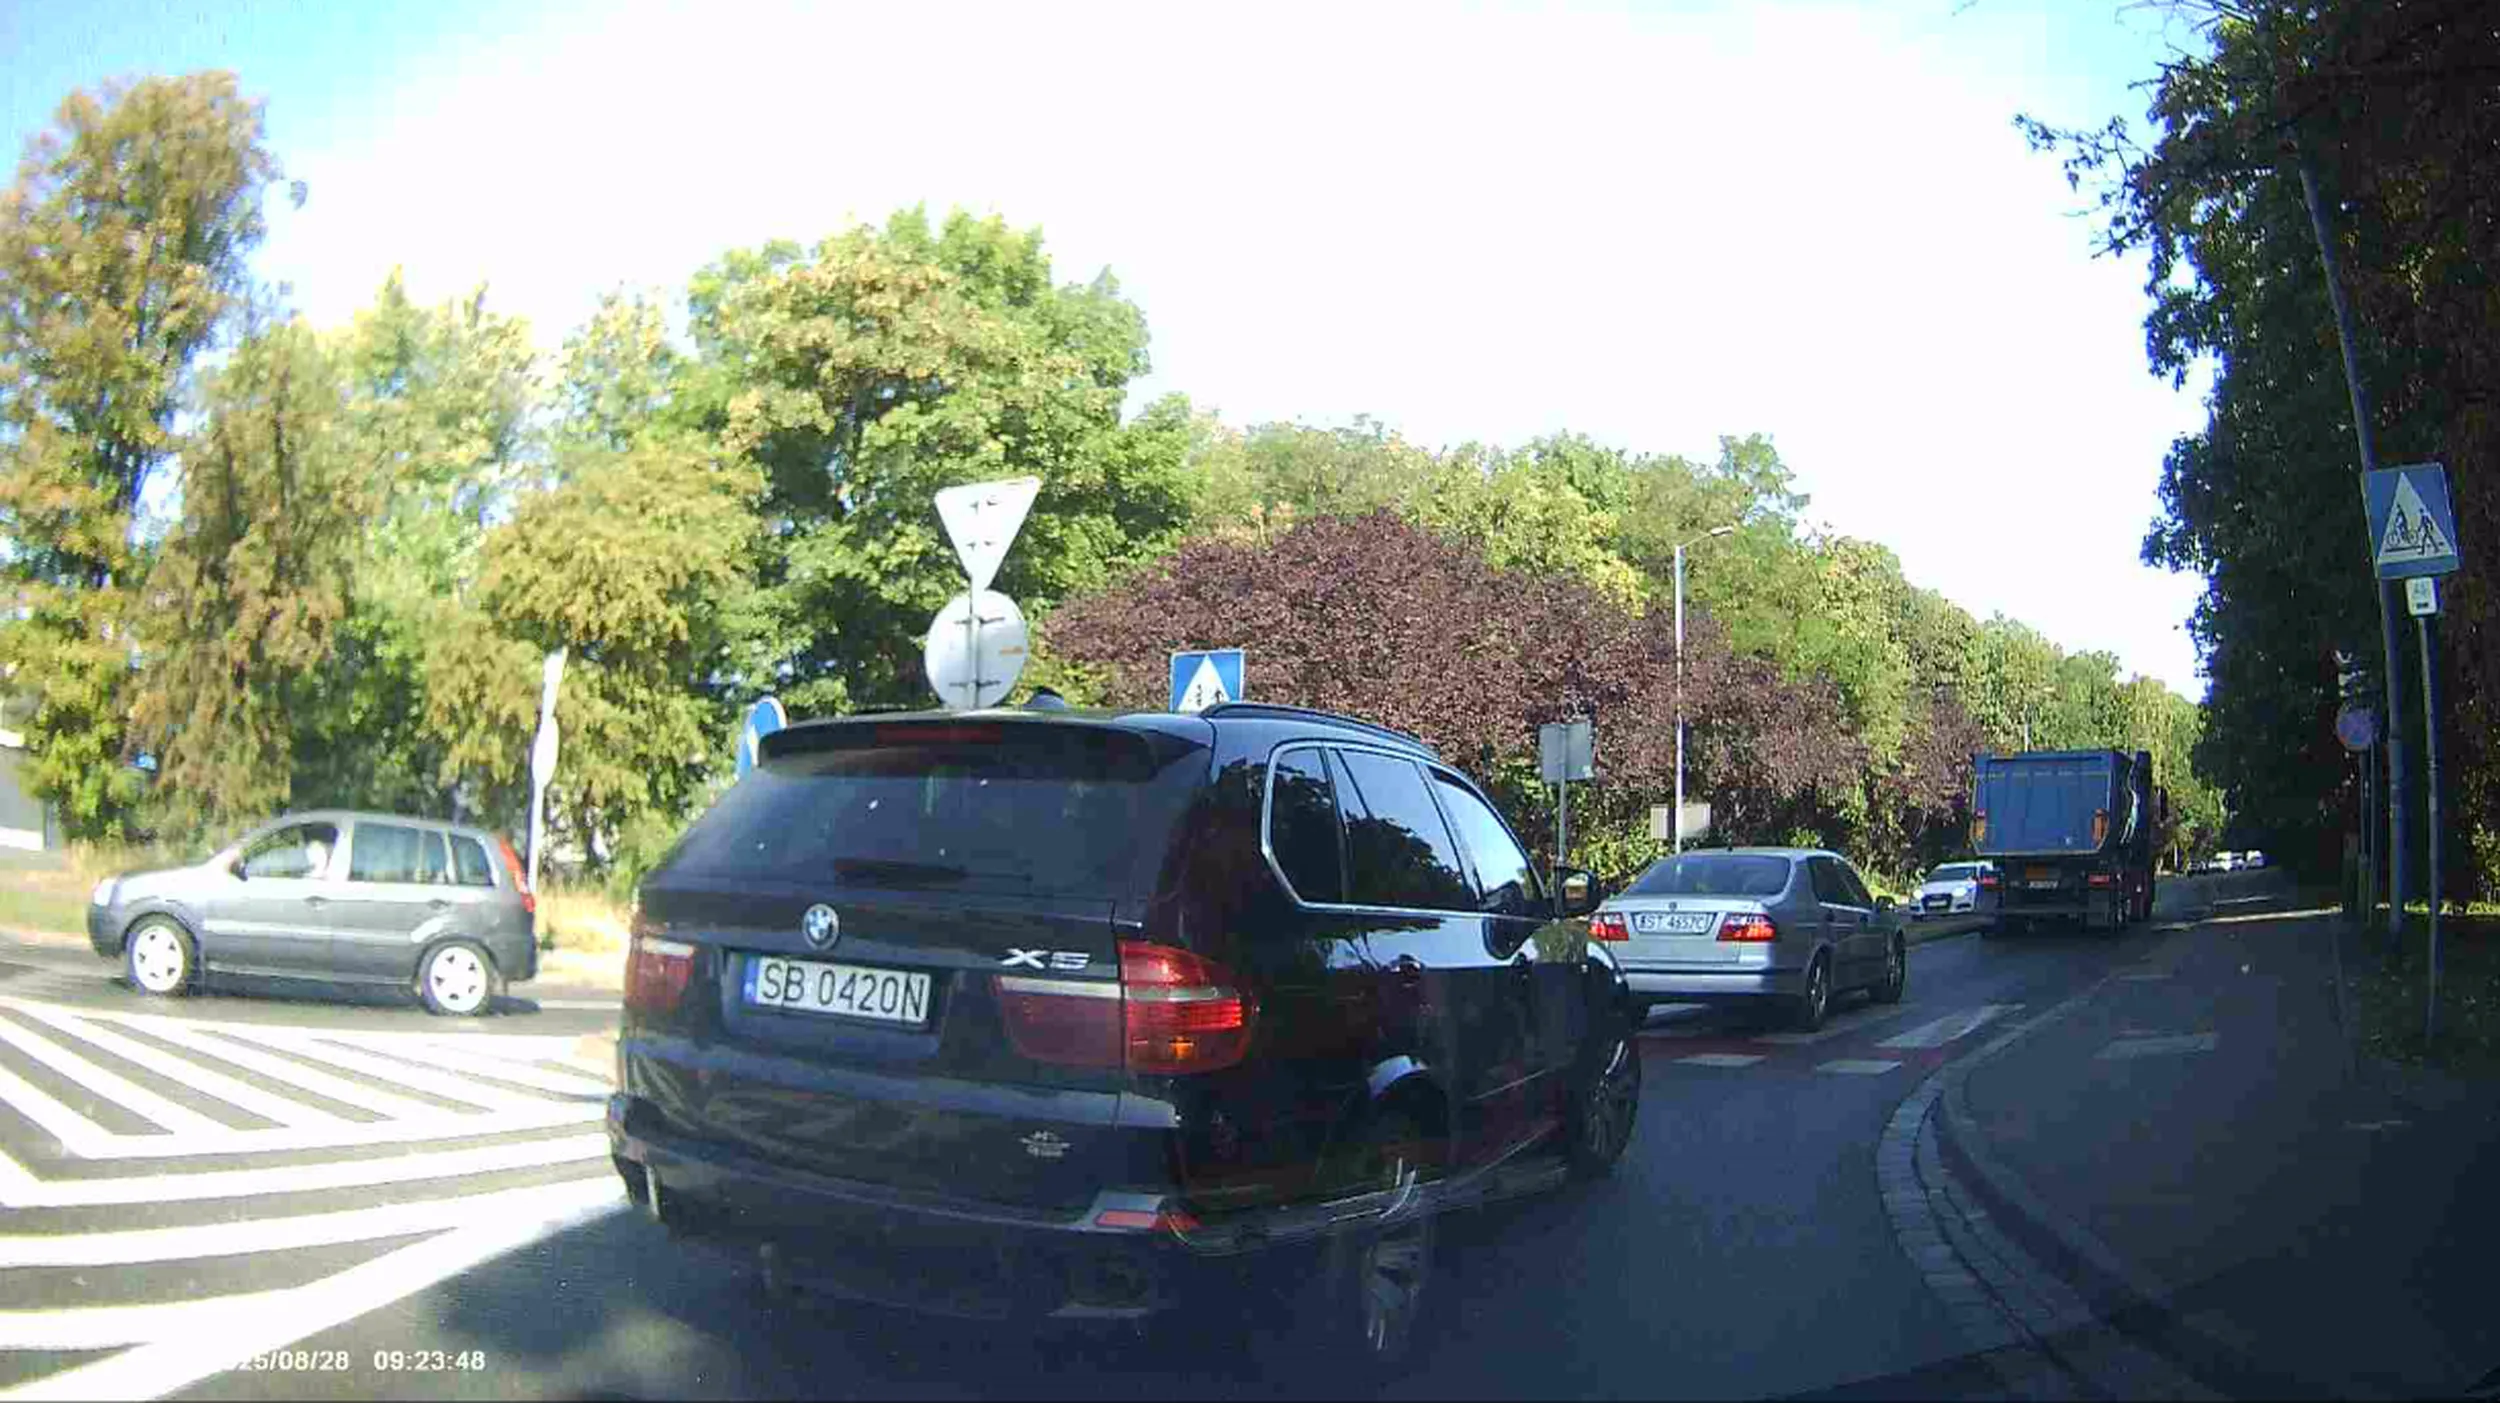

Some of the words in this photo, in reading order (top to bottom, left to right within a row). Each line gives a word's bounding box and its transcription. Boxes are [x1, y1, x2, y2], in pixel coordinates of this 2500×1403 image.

[1001, 948, 1090, 969] X5
[762, 962, 805, 1002] SB
[818, 968, 925, 1019] 0420N
